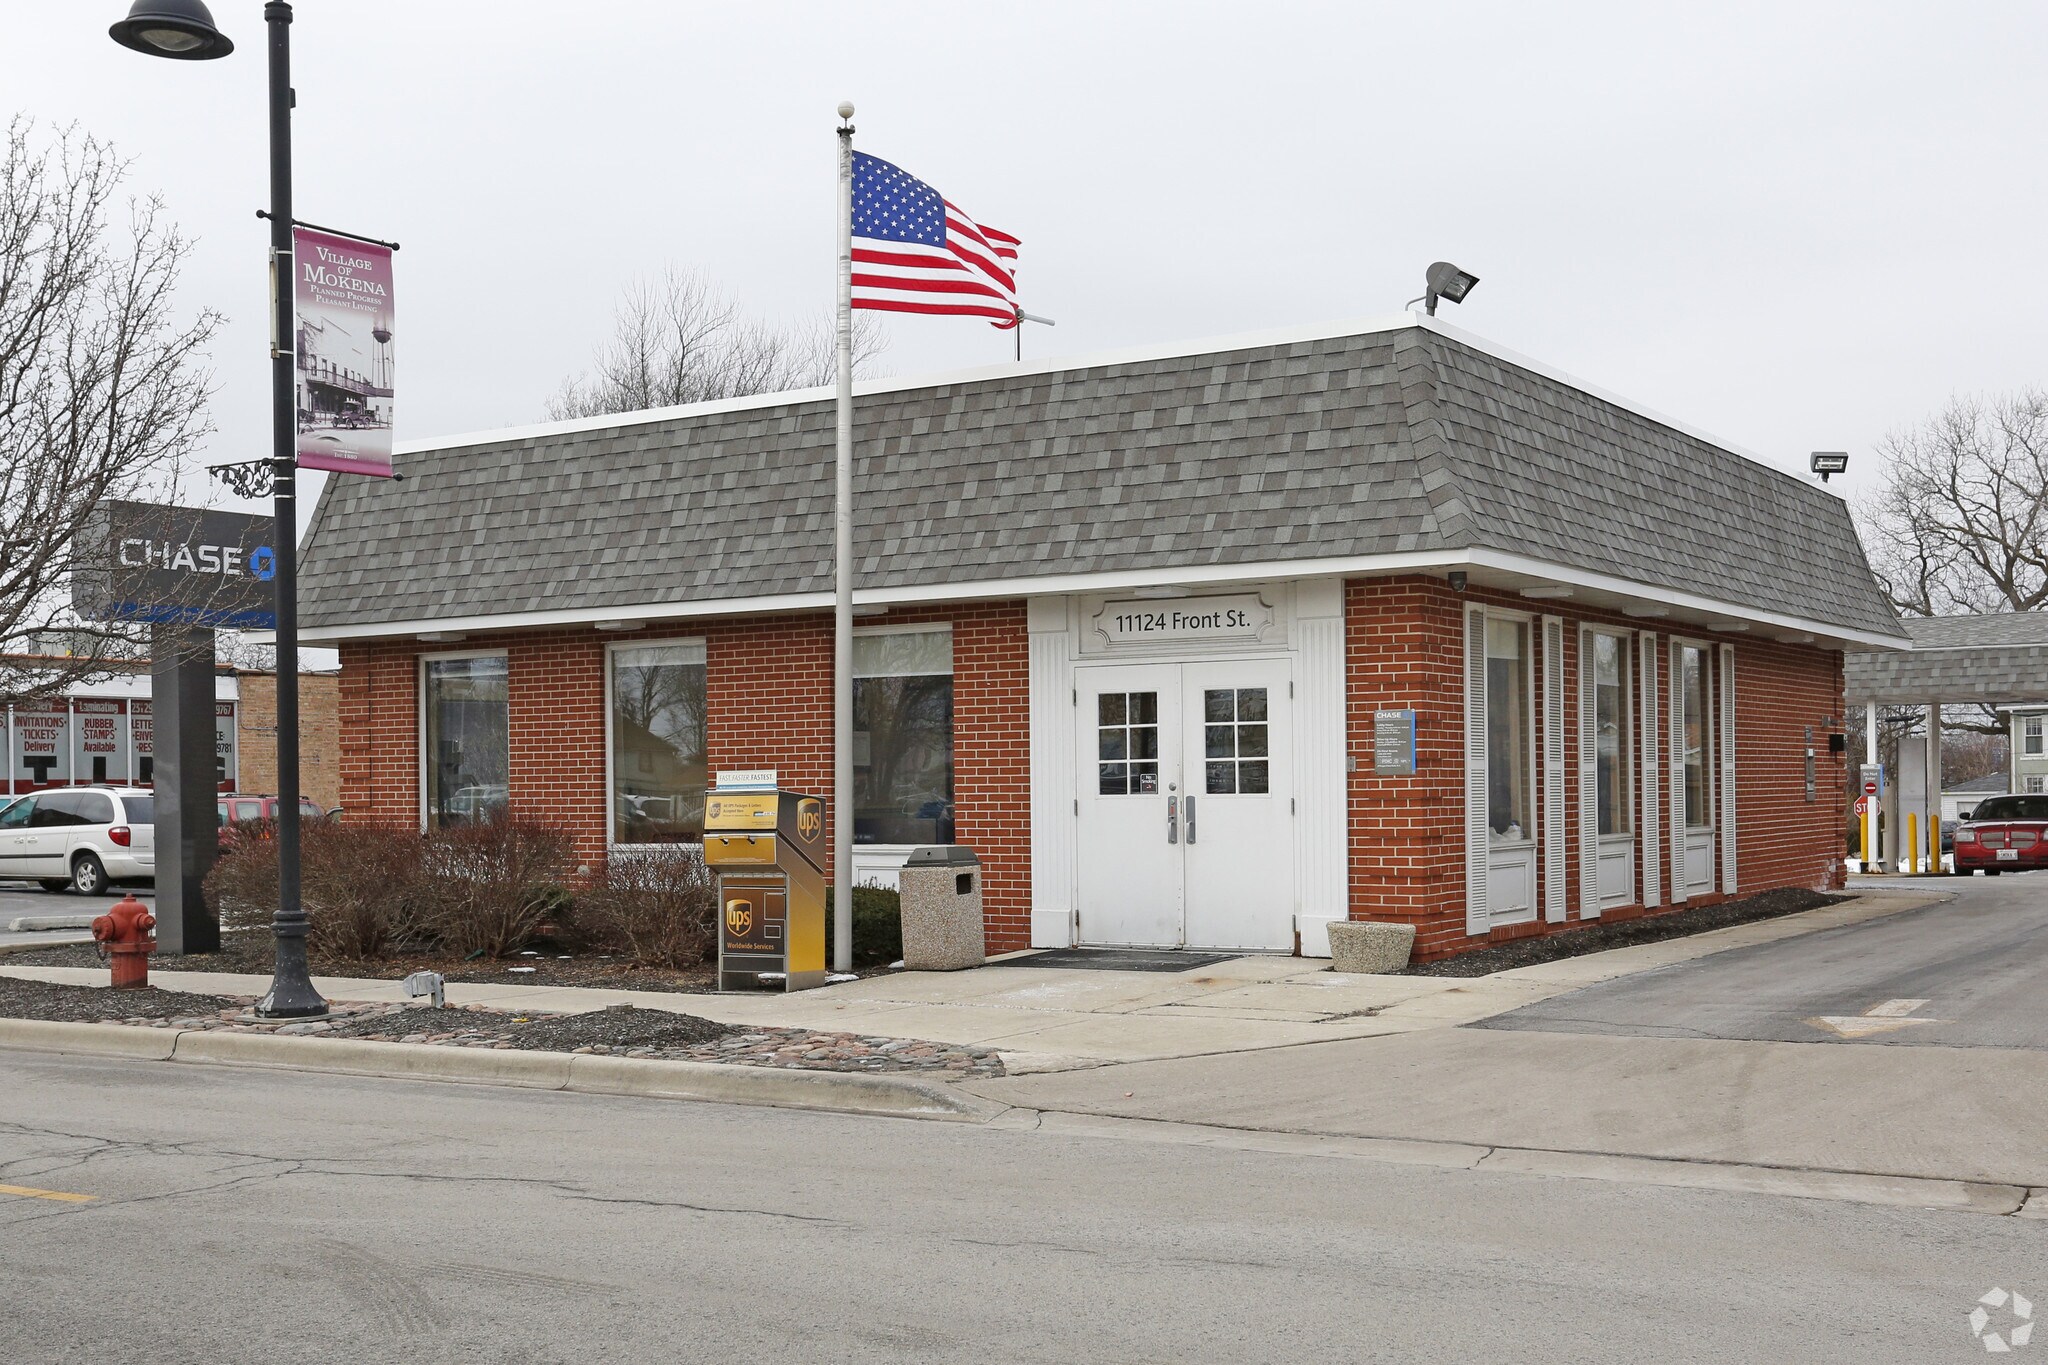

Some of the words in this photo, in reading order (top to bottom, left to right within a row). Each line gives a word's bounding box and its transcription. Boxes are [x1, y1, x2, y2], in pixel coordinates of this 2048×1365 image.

[316, 246, 372, 271] VILLAGE
[337, 265, 352, 276] OF
[303, 263, 387, 296] MOKENA
[310, 284, 345, 298] PLANNED
[315, 294, 351, 308] PLEASANT
[347, 291, 382, 305] PROGRESS
[352, 301, 378, 313] LIVING
[119, 538, 244, 576] CHASE
[1115, 612, 1167, 633] 11124
[1172, 611, 1221, 630] Front
[1226, 609, 1251, 628] St.
[1376, 711, 1402, 719] CHASE
[84, 718, 114, 729] RUBBER
[131, 718, 153, 730] LETTE
[23, 729, 56, 740] TICKETS
[83, 729, 115, 740] STAMPS
[135, 730, 153, 741] ENVE
[24, 741, 56, 753] Delivery
[83, 742, 116, 753] Available
[1856, 803, 1867, 813] ST
[799, 812, 819, 837] ups
[728, 910, 751, 931] ups
[726, 941, 753, 950] Worldwide
[753, 942, 775, 951] Services
